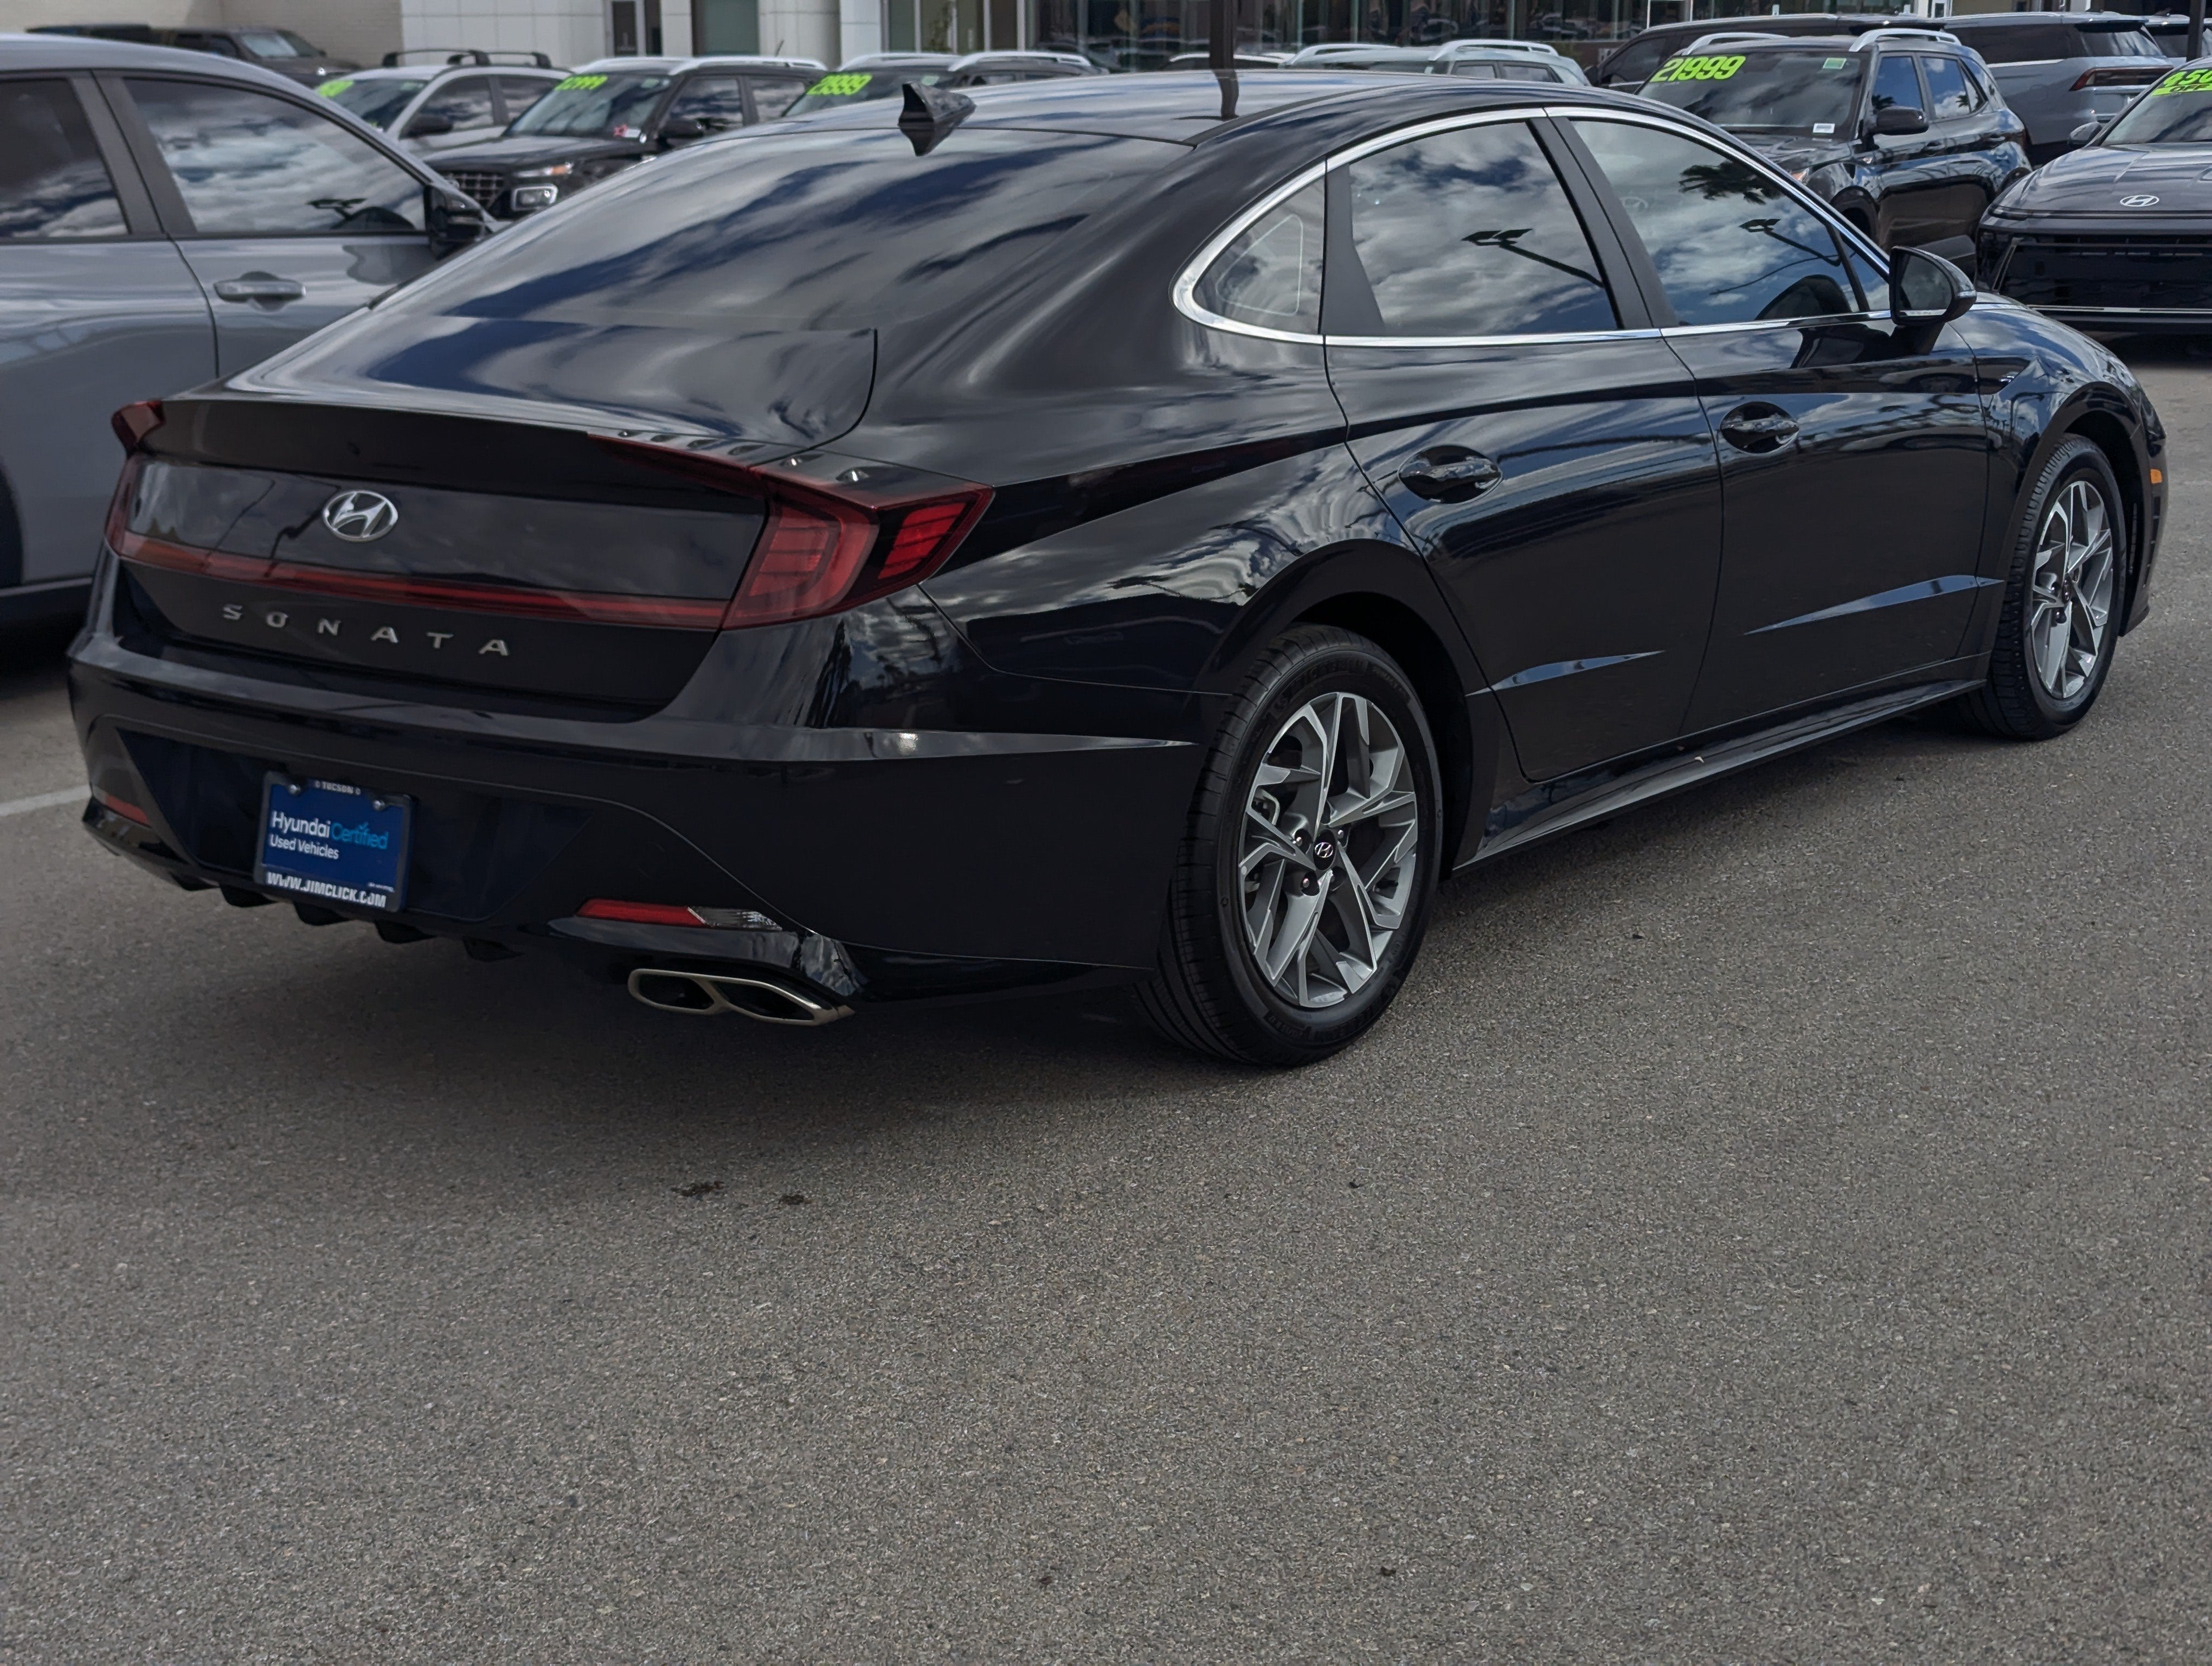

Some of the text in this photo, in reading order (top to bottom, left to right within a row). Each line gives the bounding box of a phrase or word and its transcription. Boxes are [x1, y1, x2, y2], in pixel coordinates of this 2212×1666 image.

[1650, 55, 1746, 82] 21999
[2169, 84, 2210, 92] OFF
[222, 604, 509, 656] SONATA
[271, 810, 389, 850] Hyundai Certified
[269, 834, 339, 860] Used Vehicles
[267, 871, 387, 908] WWW.JIMCLICK.COM
